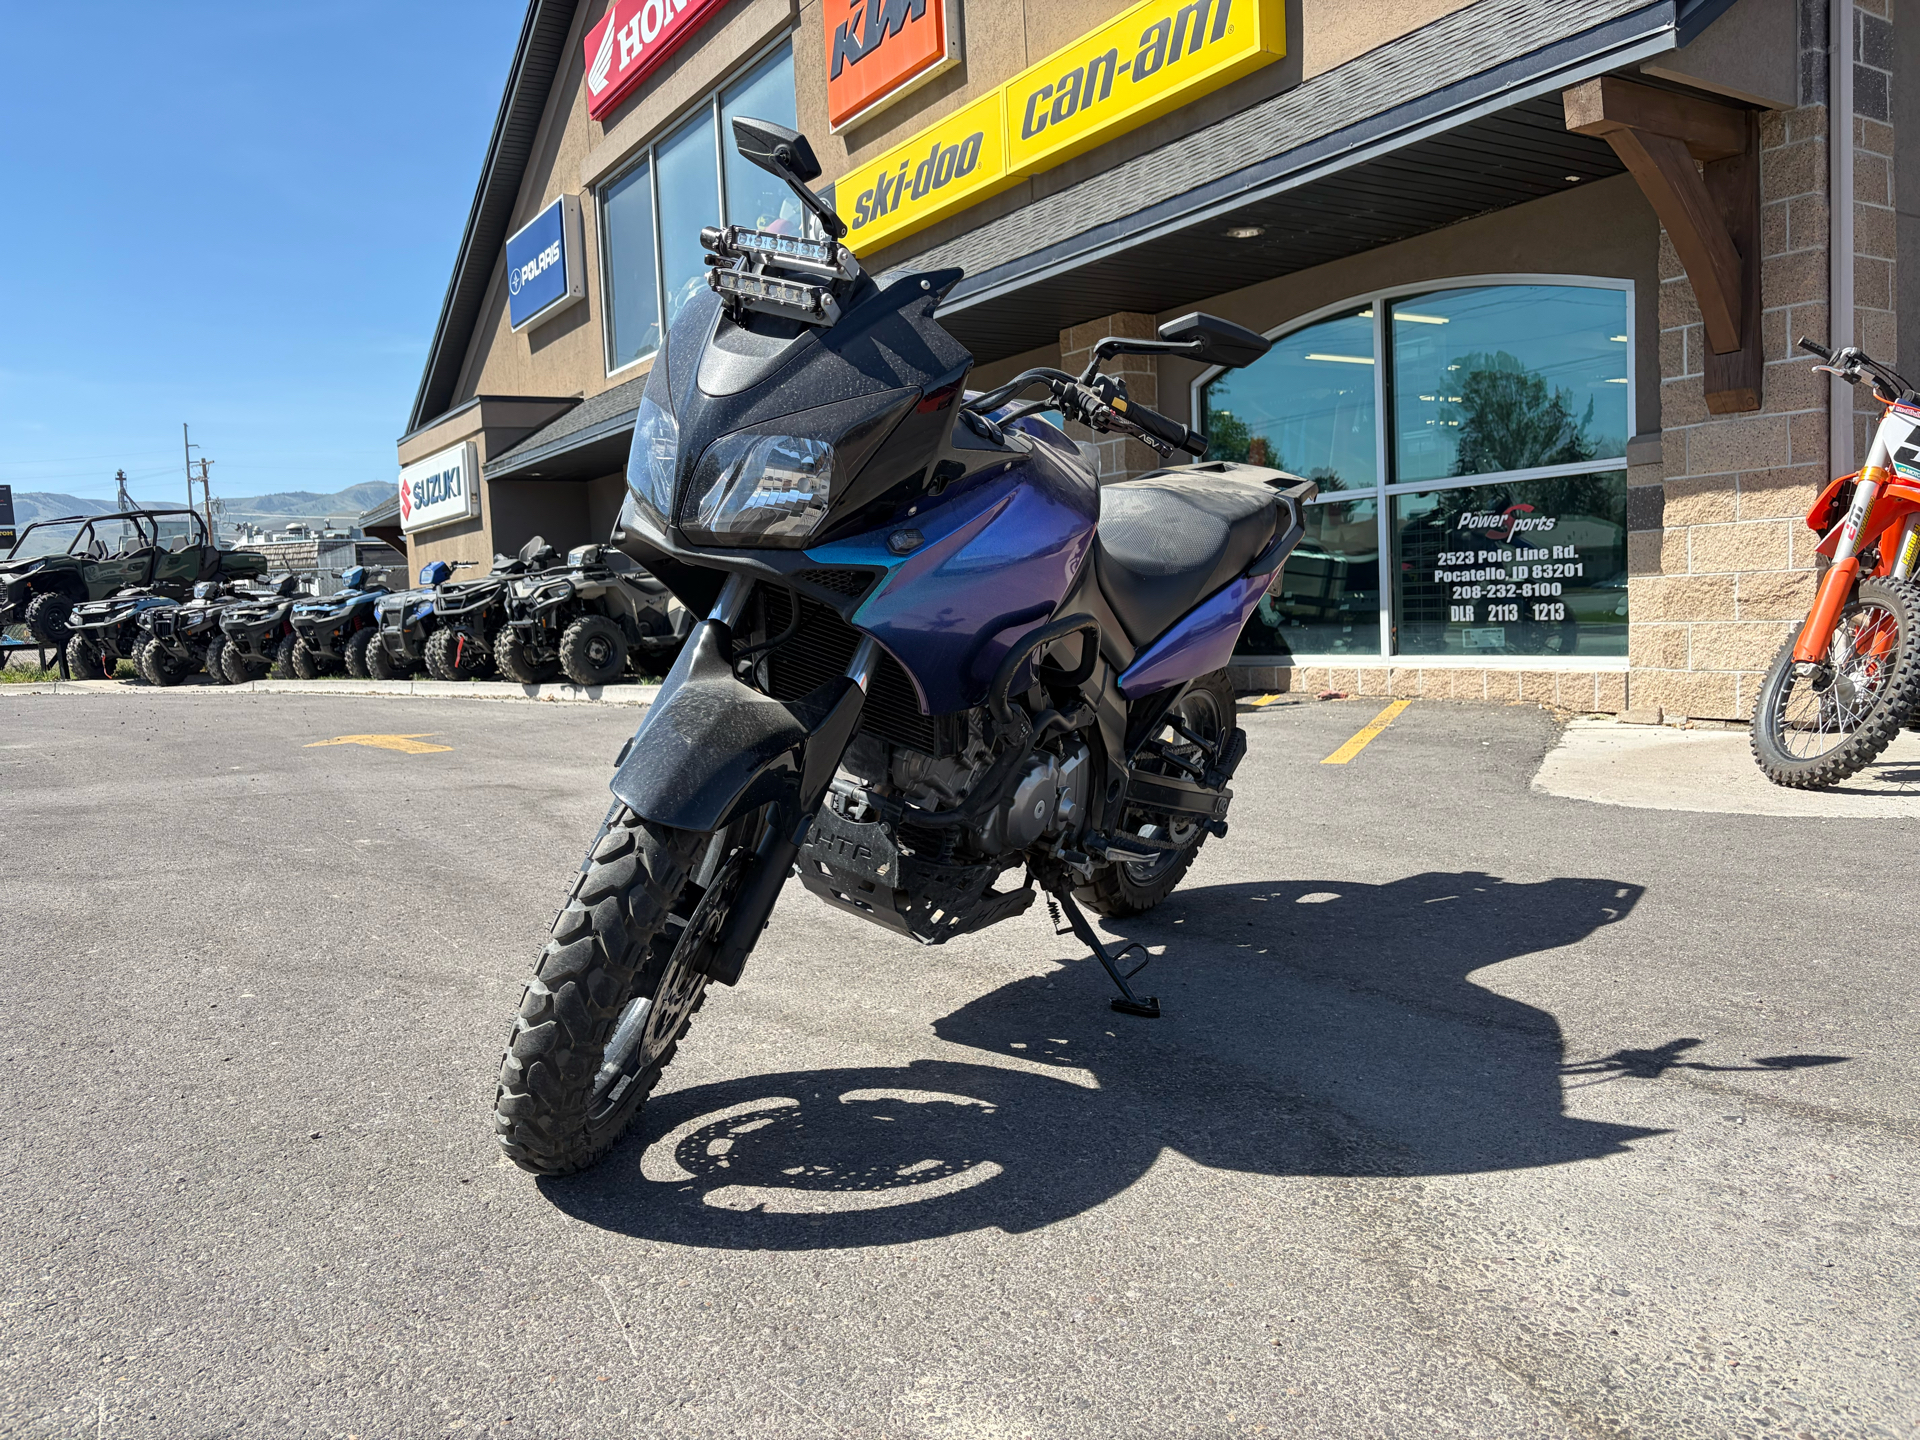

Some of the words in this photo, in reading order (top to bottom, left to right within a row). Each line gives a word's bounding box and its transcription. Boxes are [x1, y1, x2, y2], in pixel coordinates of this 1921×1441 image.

[1021, 0, 1232, 141] can-am
[852, 131, 984, 230] ski-doo
[521, 239, 560, 286] POLARIS
[1138, 433, 1160, 448] ASV
[413, 466, 461, 510] SUZUKI
[1437, 551, 1475, 566] 2523
[1478, 548, 1512, 564] Pole
[1515, 547, 1549, 562] Line
[1552, 545, 1579, 560] Rd.
[1434, 567, 1510, 583] Pocatello,
[1512, 565, 1529, 580] ID
[1532, 563, 1583, 579] 83201
[1452, 582, 1562, 600] 208-232-8100
[1450, 605, 1475, 622] DLR
[1487, 604, 1518, 621] 2113
[1532, 603, 1565, 621] 1213
[814, 828, 872, 860] HTP
